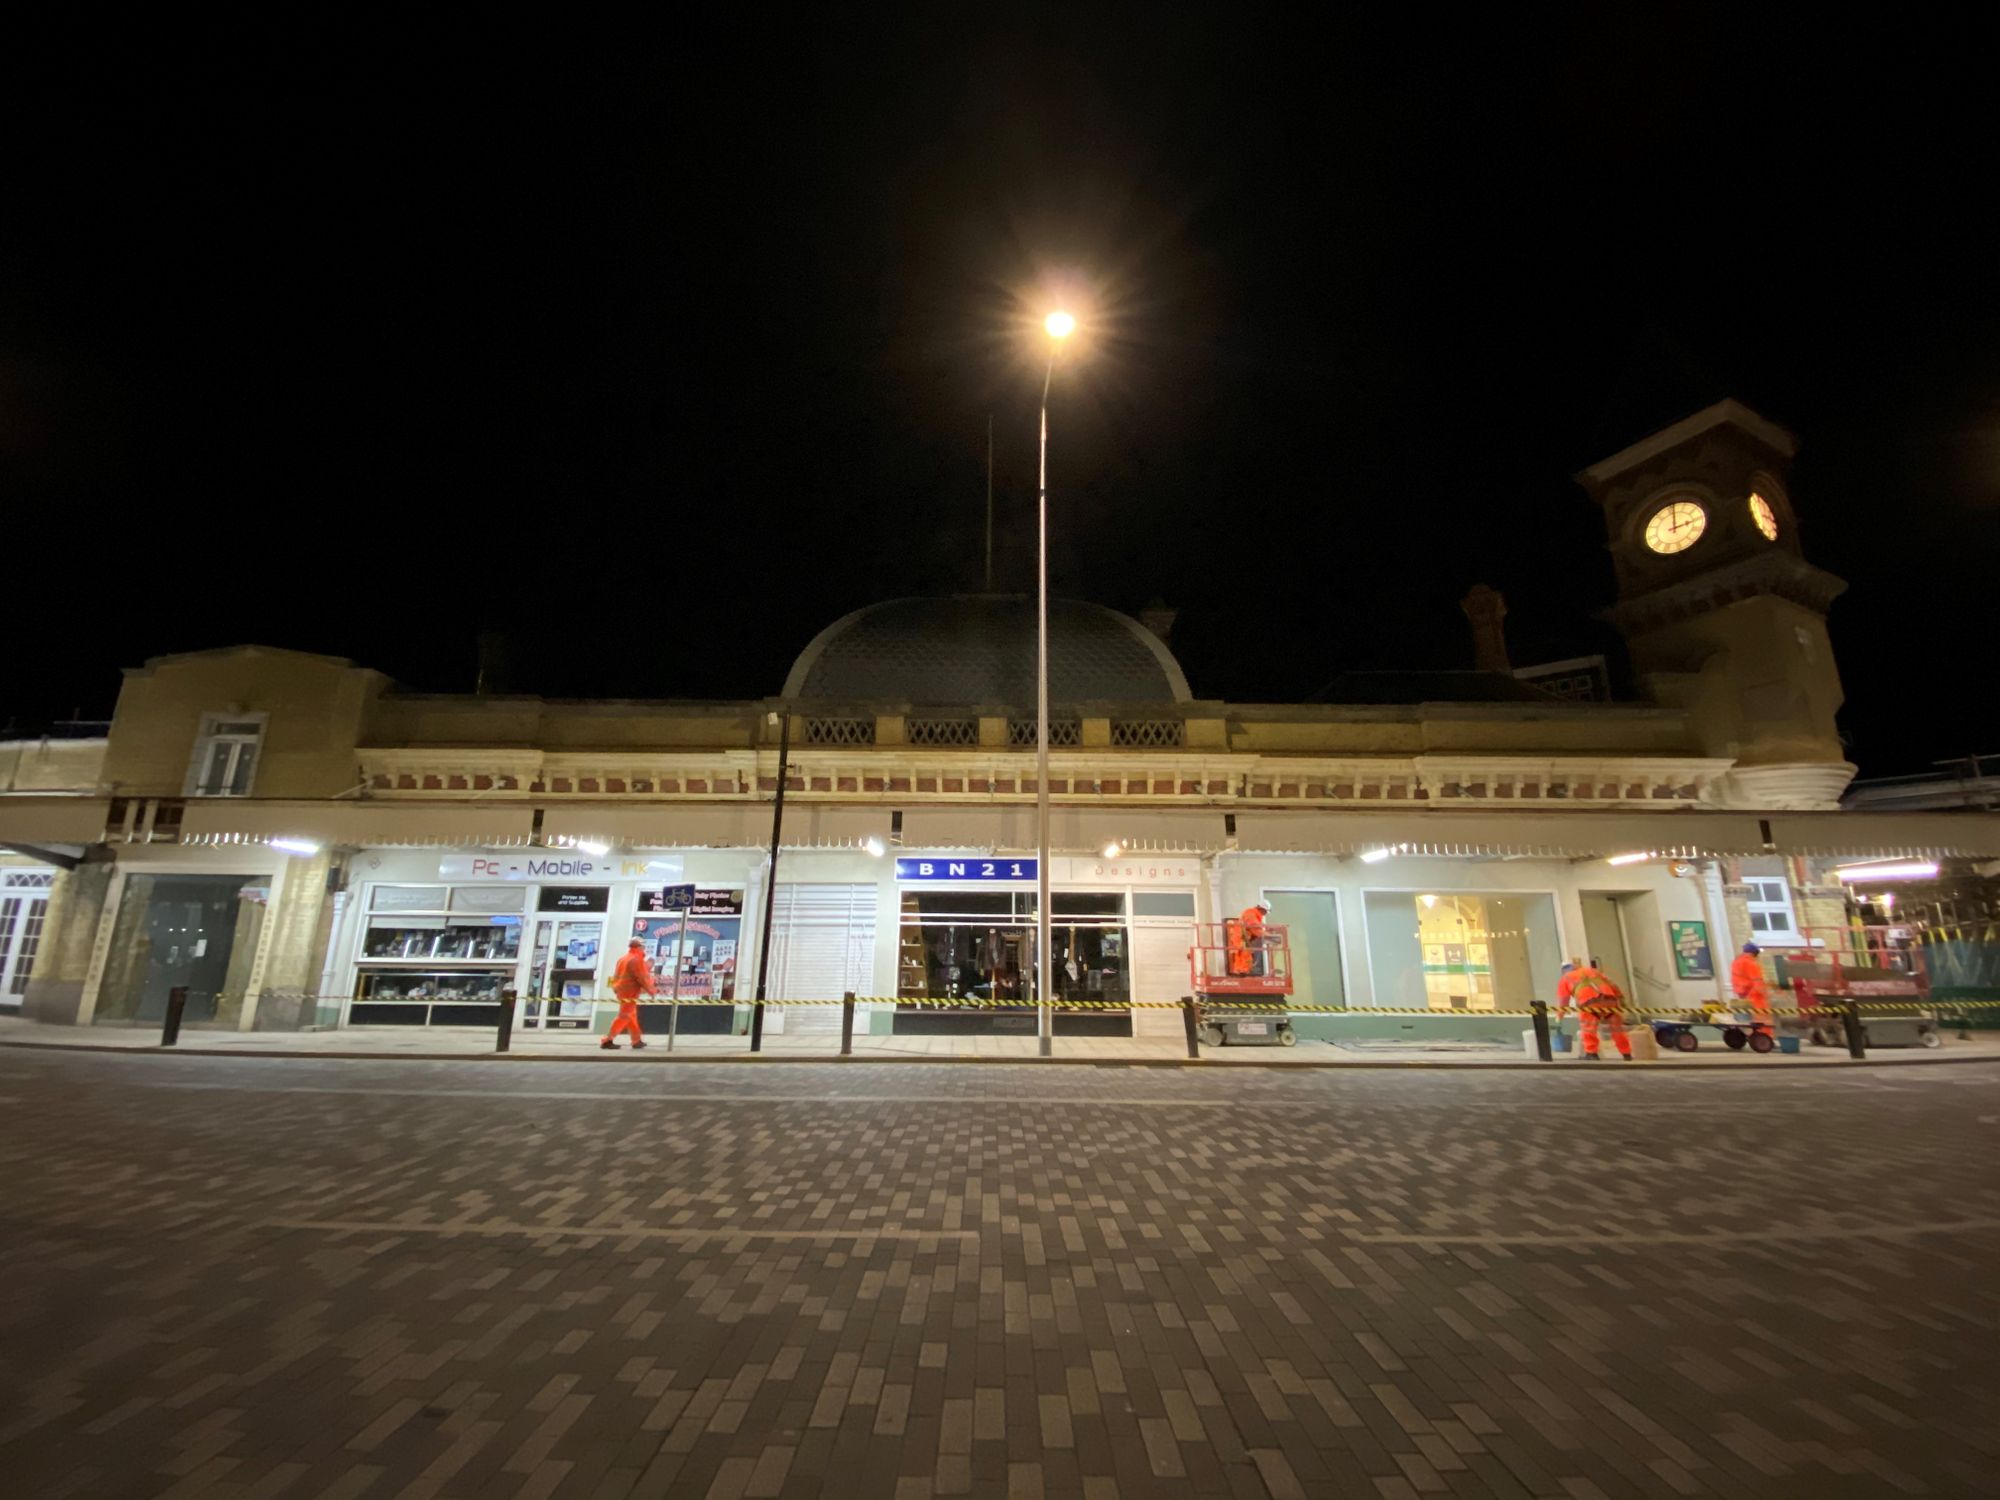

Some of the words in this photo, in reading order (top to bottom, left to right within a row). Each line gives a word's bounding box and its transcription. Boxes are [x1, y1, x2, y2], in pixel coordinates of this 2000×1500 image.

[472, 859, 500, 875] Pc
[528, 859, 593, 876] Mobile
[620, 860, 648, 875] Ink
[1095, 865, 1185, 878] Designs
